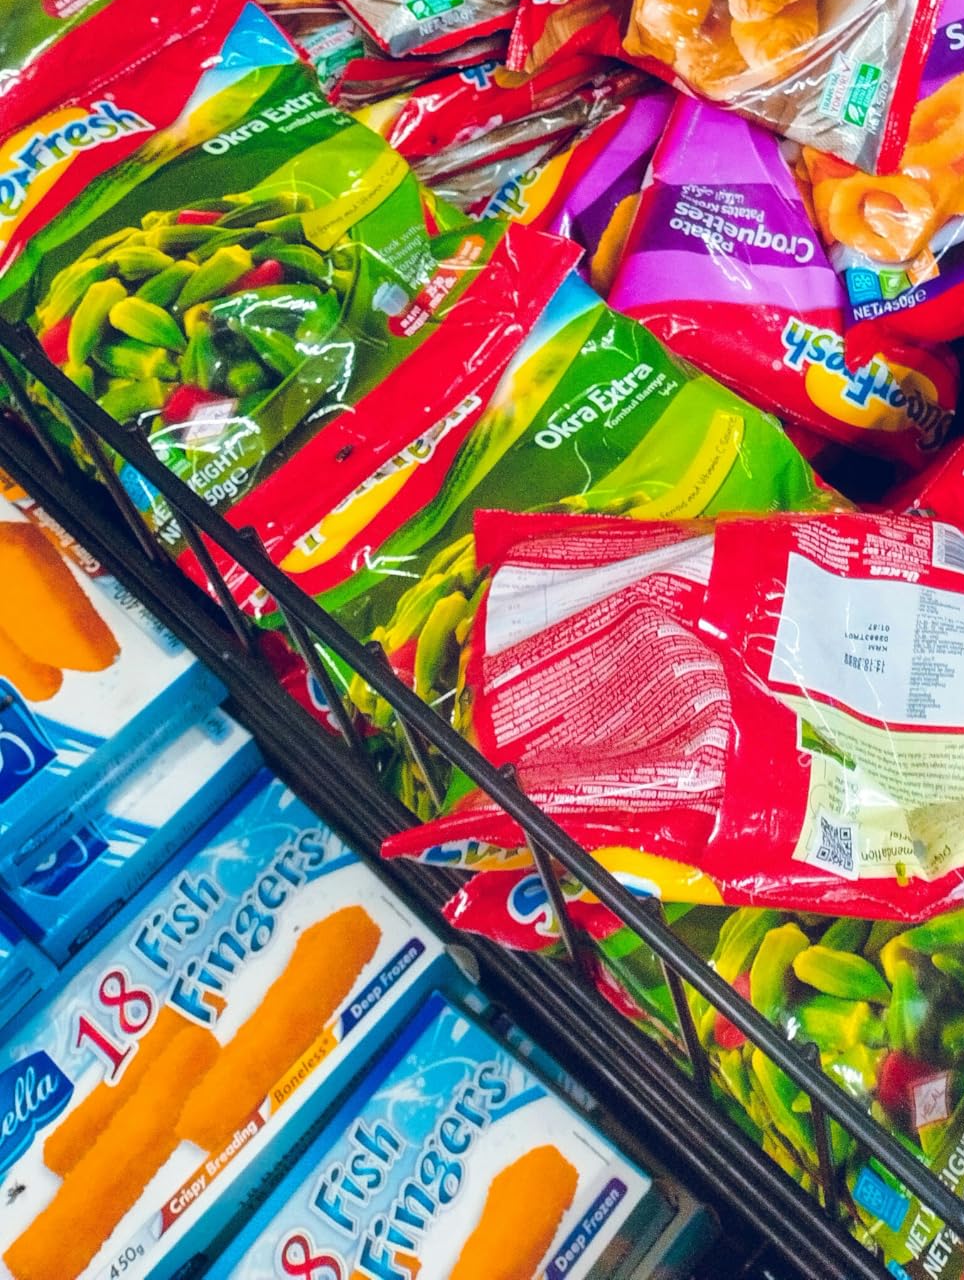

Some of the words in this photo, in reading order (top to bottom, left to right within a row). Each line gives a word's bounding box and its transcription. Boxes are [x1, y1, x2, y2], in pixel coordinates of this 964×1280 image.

[0, 102, 155, 218] erFresh
[202, 118, 270, 155] Okra
[673, 201, 815, 263] Croquettes
[711, 205, 766, 222] Patates
[534, 404, 599, 450] Okra
[586, 363, 654, 414] Extra
[604, 398, 640, 429] Tombul
[638, 372, 667, 401] Bamya
[133, 871, 220, 972] Fish
[169, 828, 326, 1025] Fingers
[76, 970, 154, 1080] 18
[350, 985, 382, 1018] Deep
[379, 945, 419, 988] Frozen
[0, 1064, 59, 1138] ella
[169, 1174, 208, 1215] Crispy
[206, 1121, 259, 1176] Breading
[313, 1122, 401, 1232] Fish
[358, 1065, 508, 1280] Fingers
[280, 1234, 342, 1280] 8
[554, 1237, 587, 1275] Deep
[582, 1187, 621, 1240] Frozen
[904, 1213, 932, 1261] NET
